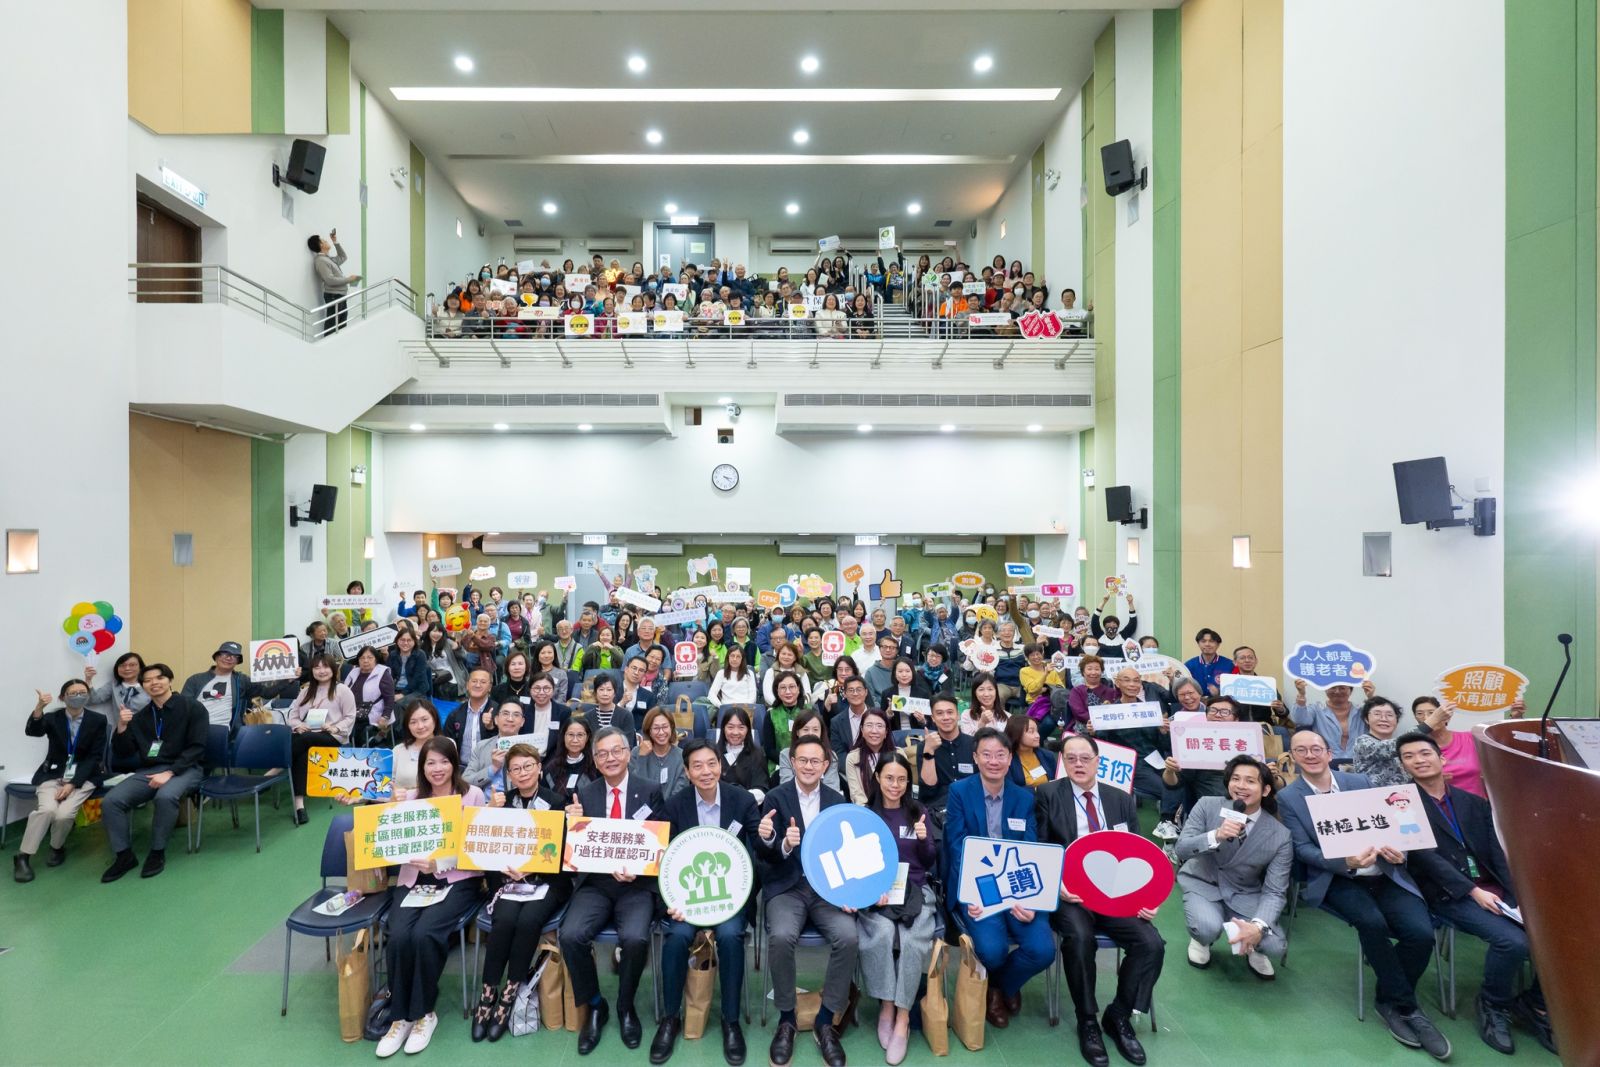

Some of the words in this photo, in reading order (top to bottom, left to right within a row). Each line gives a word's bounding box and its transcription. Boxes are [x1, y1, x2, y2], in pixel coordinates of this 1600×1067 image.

[1300, 651, 1353, 662] 人人都是
[1300, 663, 1348, 677] 護老者
[1463, 671, 1505, 691] 照顧
[1453, 691, 1507, 706] 不再孤單
[328, 768, 371, 778] 精益求精
[378, 808, 440, 826] 安老服務業
[1317, 813, 1390, 836] 積極上進
[365, 822, 453, 843] 社區照顧及支援
[466, 824, 552, 840] 用照顧長者經驗
[588, 831, 646, 845] 安老服務業
[464, 841, 539, 856] 獲取認可資歷
[574, 844, 656, 862] 「過往資歷認可」
[1007, 867, 1036, 895] 讚
[686, 903, 735, 917] 香港老年學會
